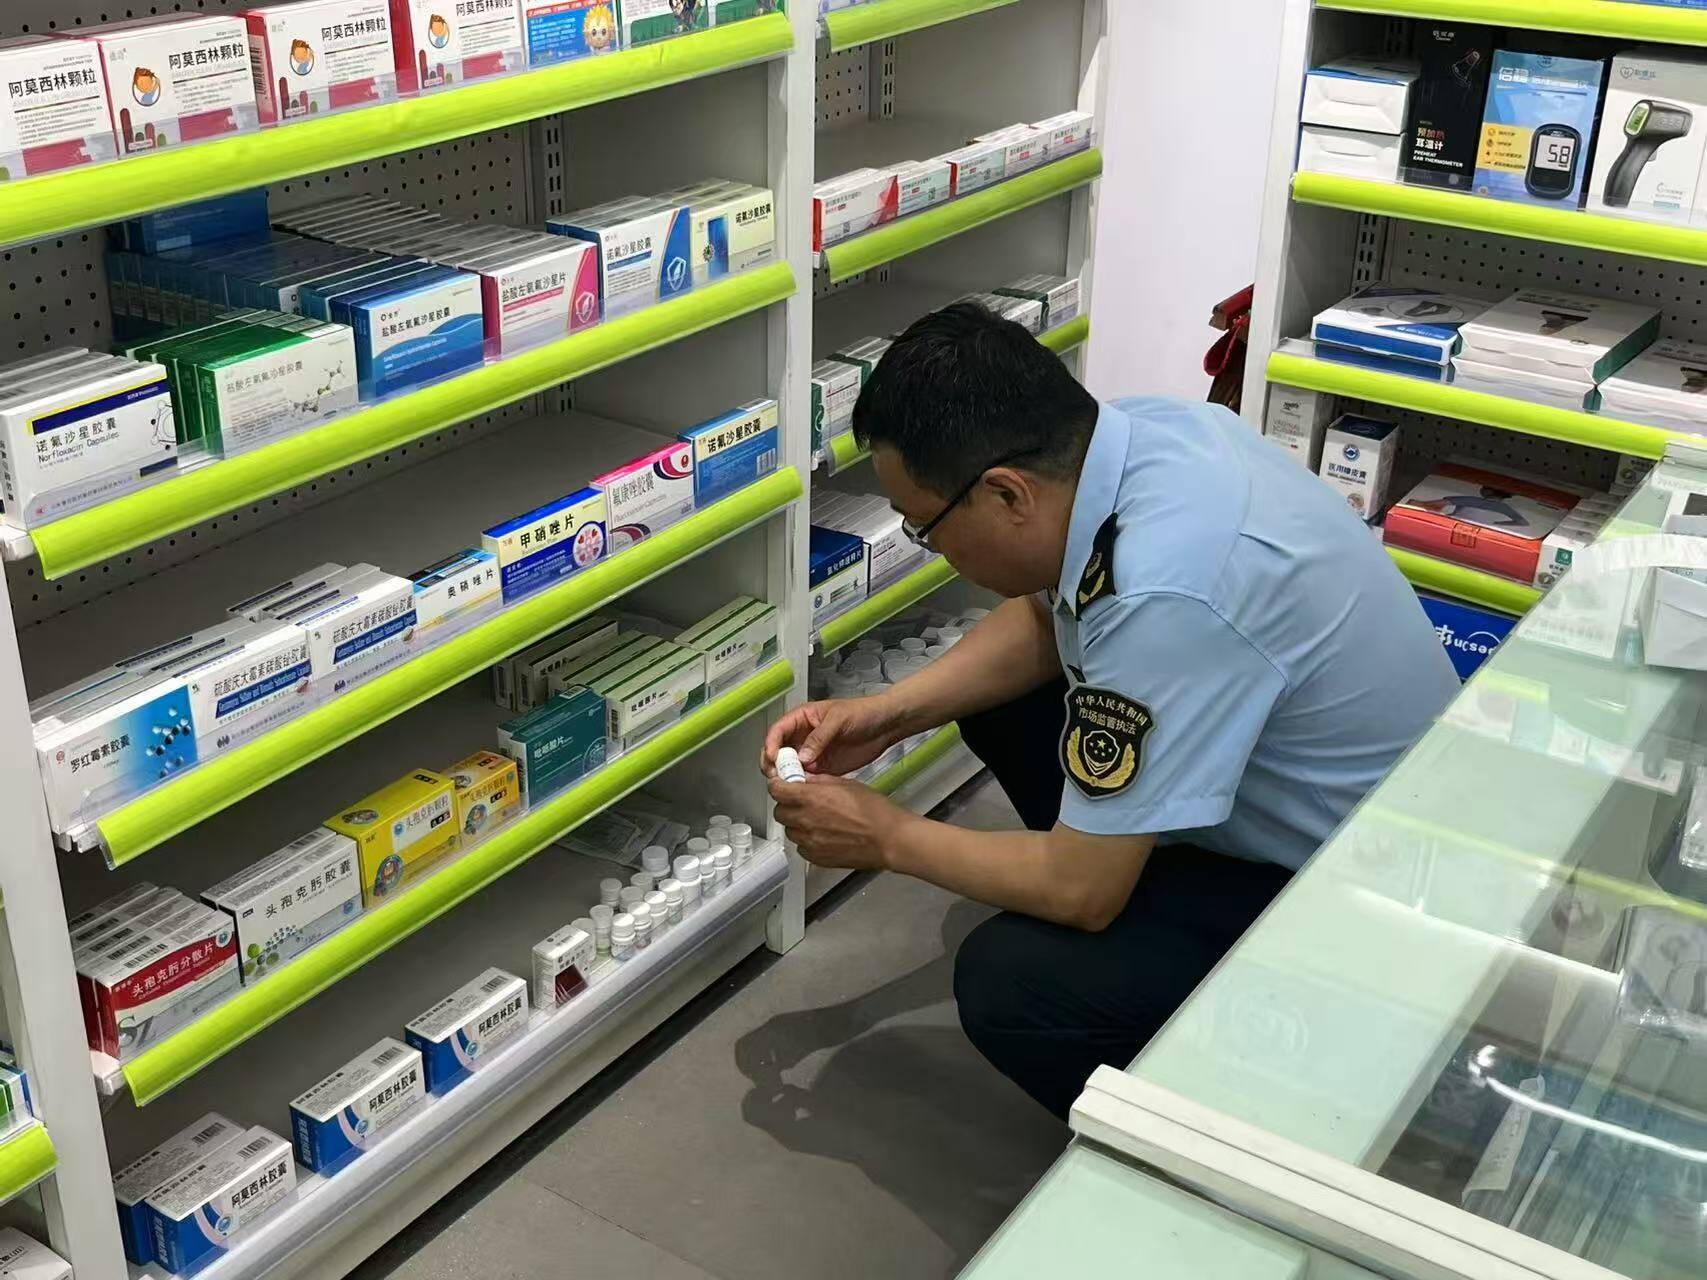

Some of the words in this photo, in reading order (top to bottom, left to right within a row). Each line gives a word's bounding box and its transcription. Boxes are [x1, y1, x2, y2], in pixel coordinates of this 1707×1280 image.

[321, 17, 387, 41] 阿莫西林颗粒
[169, 43, 245, 69] 阿莫西林颗粒
[8, 68, 97, 98] 阿莫西林颗粒
[1415, 138, 1443, 150] 耳温计
[607, 237, 652, 260] 诺氟沙星胶囊
[502, 272, 566, 302] 盐酸左氧氟沙星片
[382, 306, 450, 337] 盐酸左氧氟沙星胶囊
[36, 417, 117, 452] 诺氟沙星胶囊
[38, 443, 84, 463] Norfloxacin
[86, 431, 120, 448] Capsules
[707, 417, 761, 453] 诺氟沙星胶囊
[612, 471, 655, 506] 氟康唑胶囊
[520, 513, 575, 548] 甲硝唑片
[447, 567, 495, 599] 奥硝唑片
[1075, 694, 1148, 726] 中华人民共和国
[1079, 706, 1137, 735] 市场监管执法
[70, 733, 131, 774] 罗红霉素胶囊
[265, 859, 351, 919] 头孢克肟胶囊
[132, 941, 214, 998] 头孢克肟分散片
[478, 996, 523, 1037] 阿莫西林胶囊
[369, 1069, 418, 1113] 阿莫西林胶囊
[231, 1161, 288, 1210] 阿莫西林胶囊
